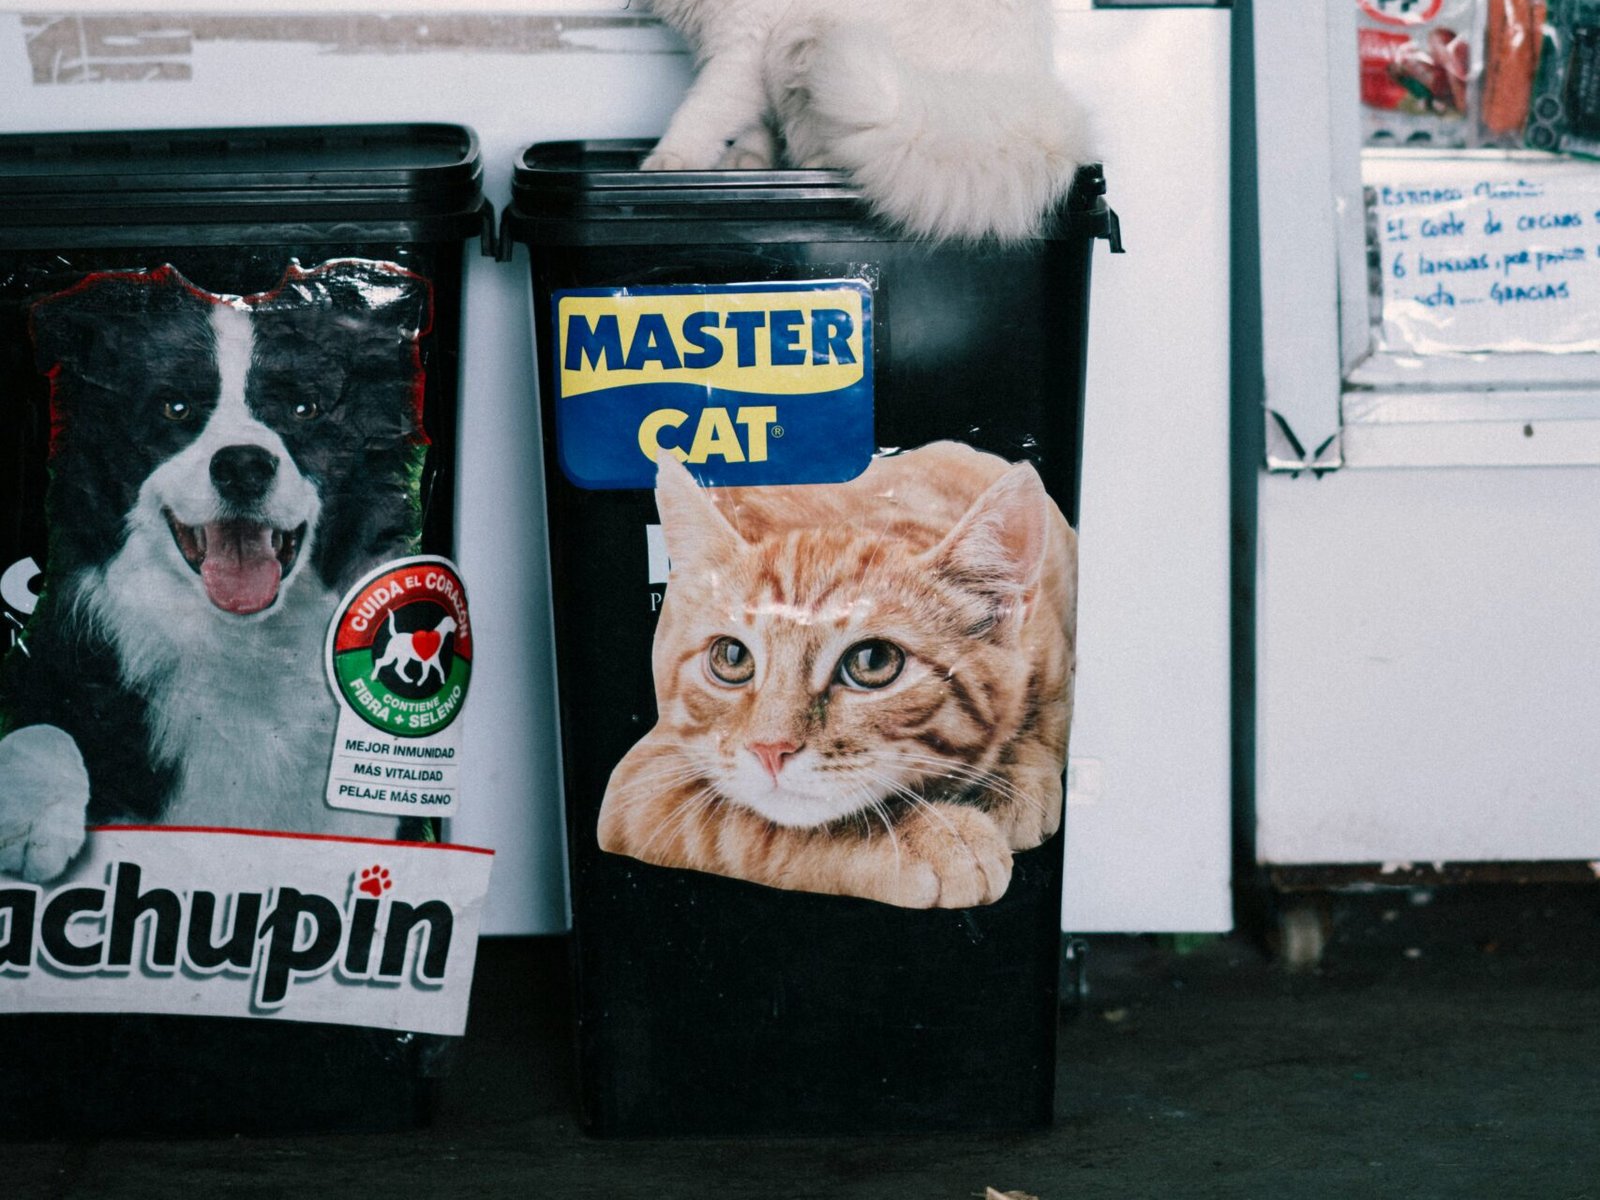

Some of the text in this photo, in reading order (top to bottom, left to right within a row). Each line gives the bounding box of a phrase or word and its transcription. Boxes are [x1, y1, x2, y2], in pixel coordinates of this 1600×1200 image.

[1393, 252, 1406, 278] 6
[564, 308, 857, 372] MASTER
[351, 572, 468, 639] CUIDA EL CORAZÓN
[349, 677, 391, 723] FIBRA
[408, 685, 462, 728] SELENIO
[383, 693, 440, 713] CONTIENE
[345, 738, 455, 759] MEJOR INMUNIDAD
[353, 761, 443, 782] MÁS VITALIDAD
[338, 784, 451, 806] PELAJE MÁS SANO
